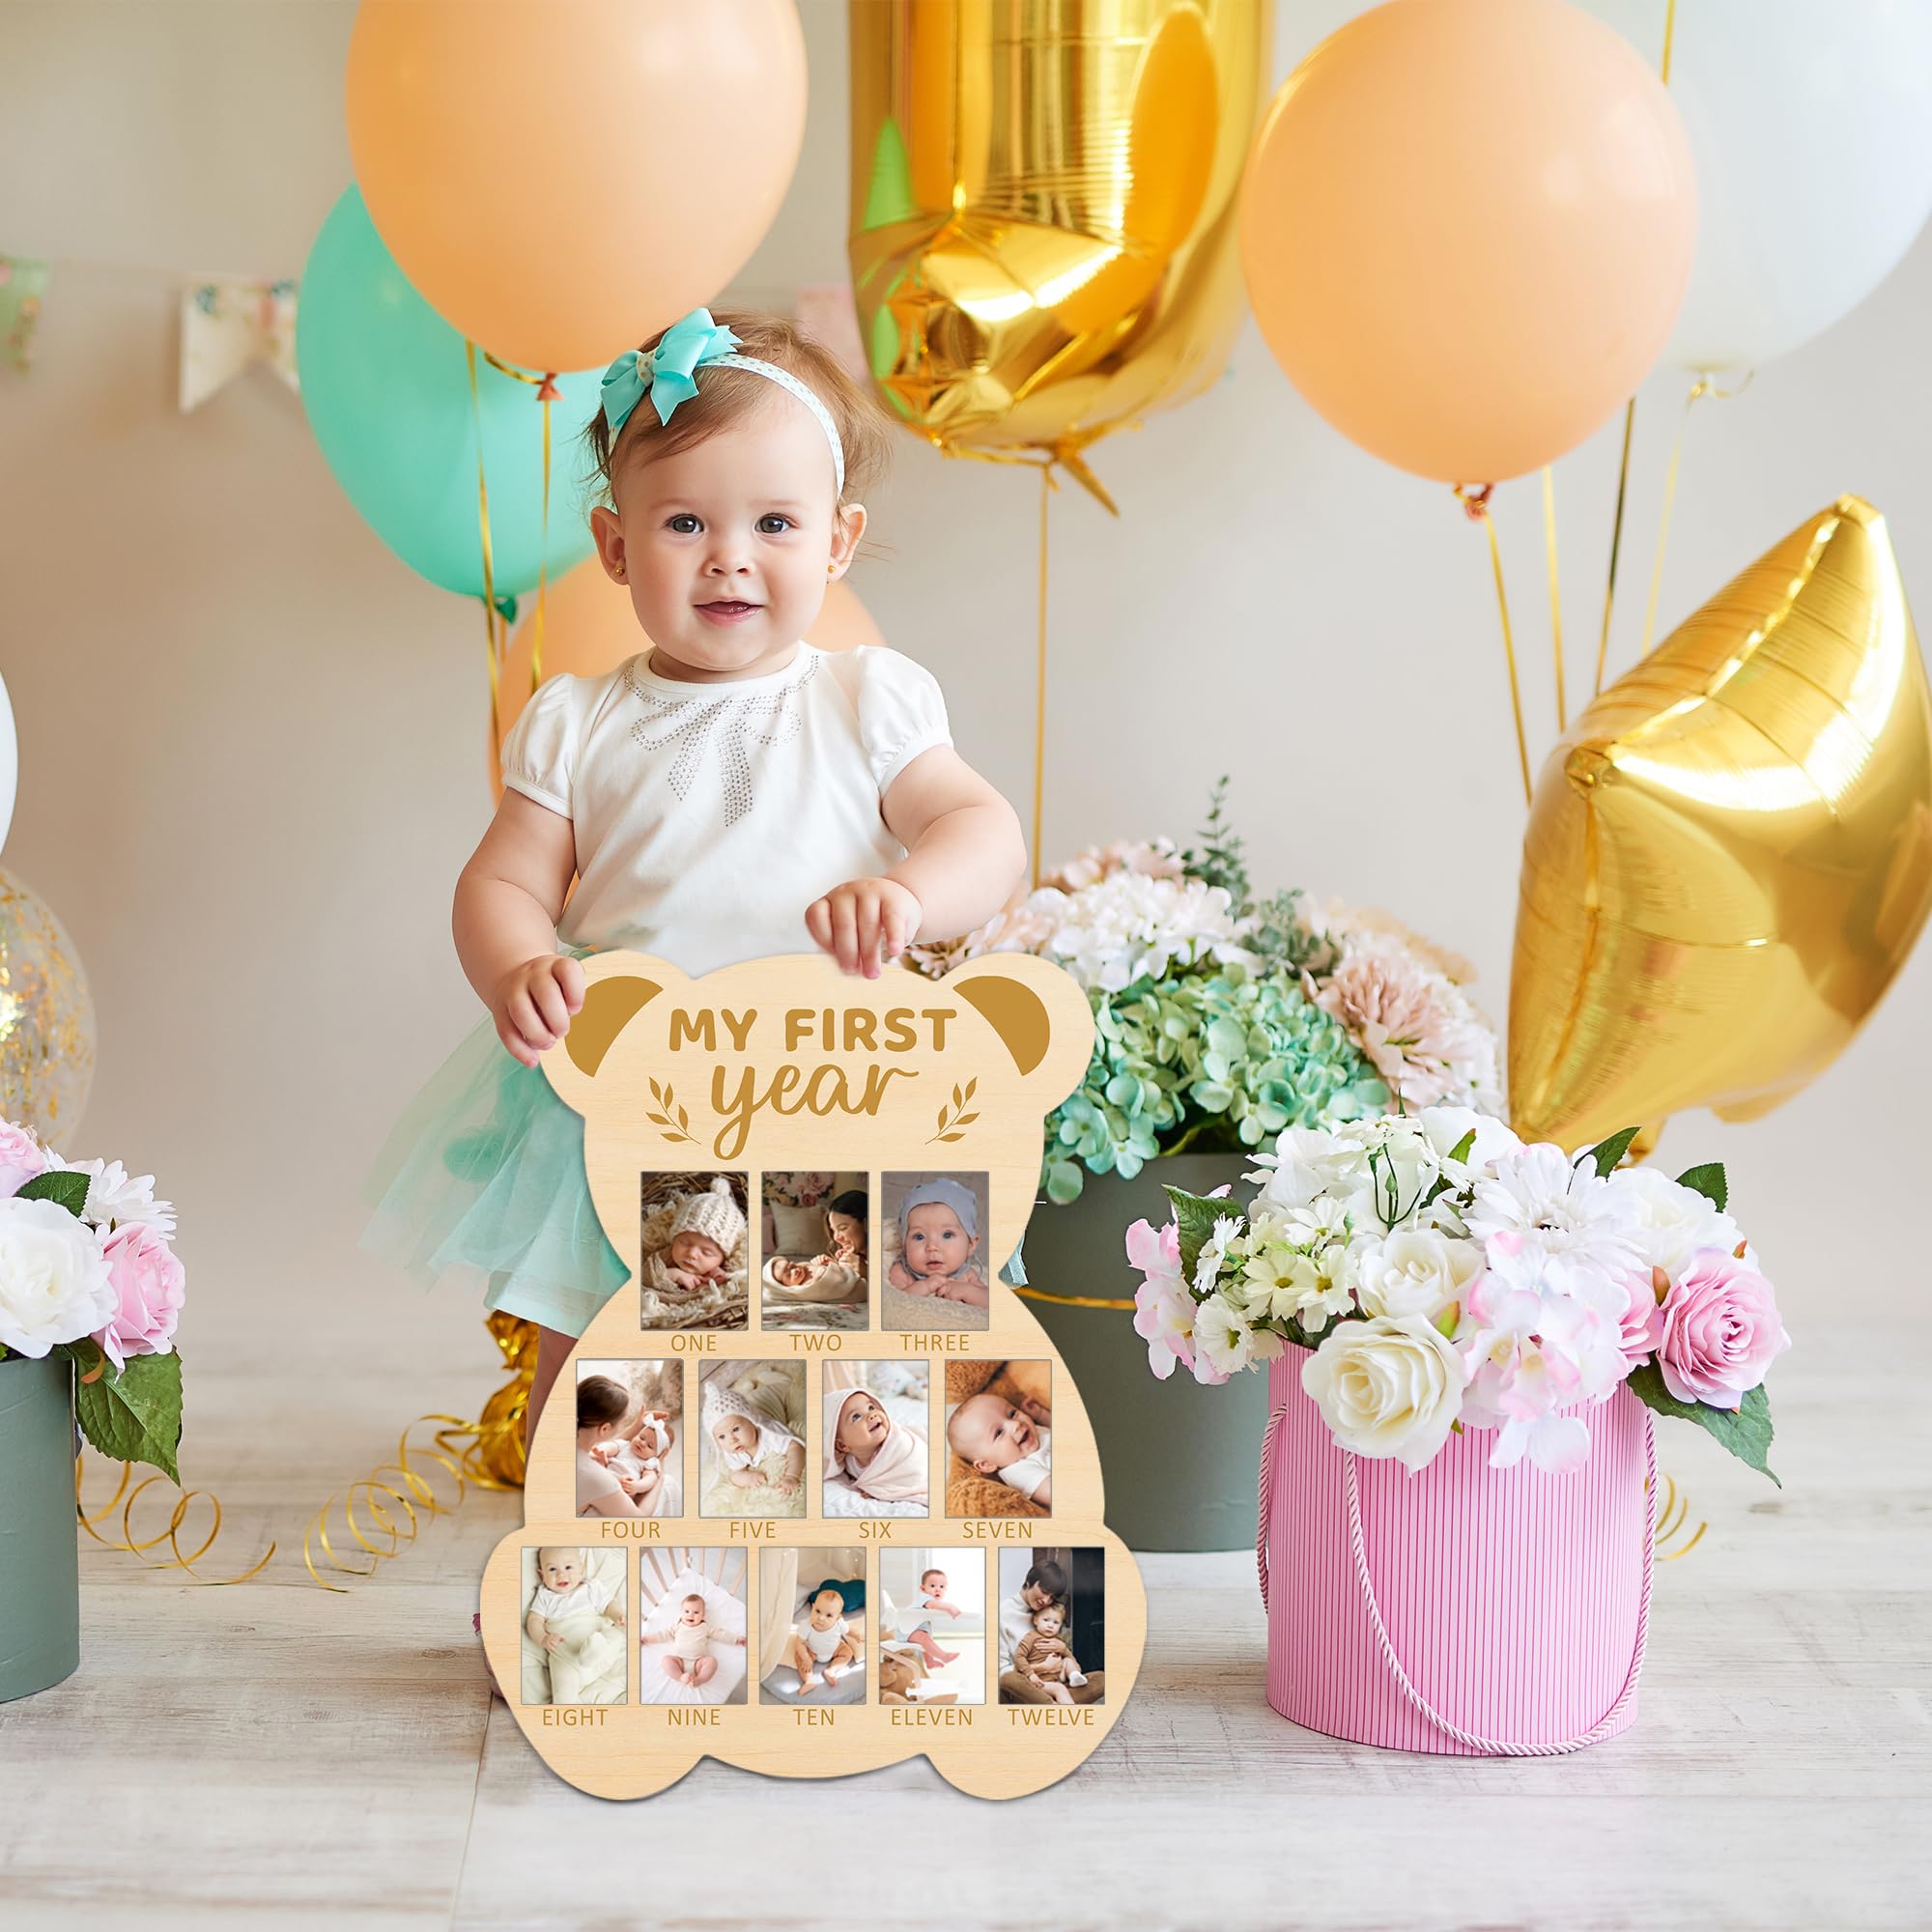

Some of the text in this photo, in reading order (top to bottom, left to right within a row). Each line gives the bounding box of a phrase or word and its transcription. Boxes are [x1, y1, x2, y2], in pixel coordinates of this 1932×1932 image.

[668, 1008, 957, 1053] MY FIRST
[711, 1064, 920, 1161] year
[670, 1334, 717, 1352] ONE
[788, 1334, 842, 1351] TWO
[899, 1334, 970, 1351] THREE
[601, 1520, 661, 1539] FOUR
[730, 1521, 776, 1539] FIVE
[859, 1521, 892, 1539] SIX
[962, 1521, 1032, 1539] SEVEN
[542, 1708, 609, 1726] EIGHT
[668, 1708, 721, 1726] NINE
[792, 1708, 835, 1726] TEN
[892, 1708, 973, 1726] ELEVEN
[1007, 1708, 1094, 1726] TWELVE
